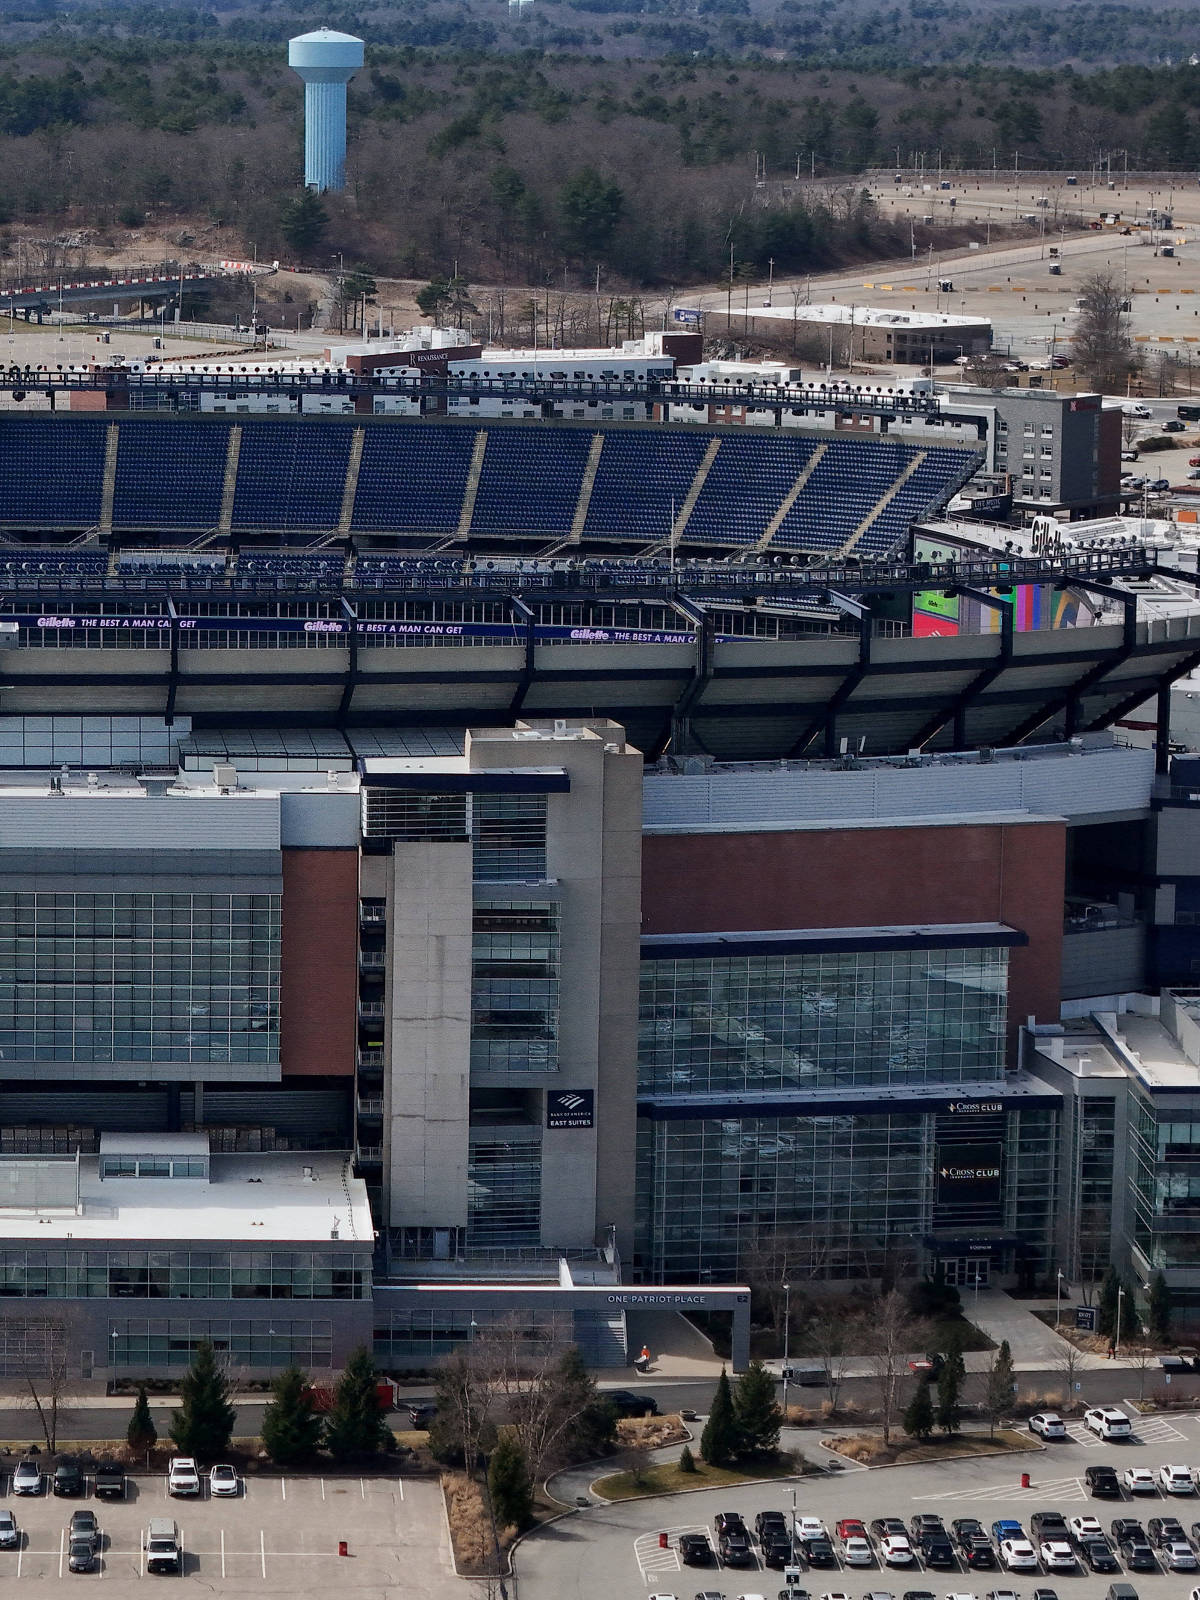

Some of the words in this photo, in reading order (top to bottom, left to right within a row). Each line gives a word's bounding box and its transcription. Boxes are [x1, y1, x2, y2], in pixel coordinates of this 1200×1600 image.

[37, 617, 76, 628] Gillette
[81, 619, 97, 627] THE
[100, 619, 120, 627] BEST
[122, 619, 129, 627] A
[132, 619, 154, 628] MAN
[157, 620, 172, 628] CA
[179, 620, 197, 628] GET
[304, 621, 342, 632] Gillette
[366, 624, 387, 632] BEST
[389, 624, 396, 632] A
[398, 624, 421, 633] MAN
[424, 625, 443, 634] CAN
[446, 626, 464, 634] GET
[571, 628, 609, 640] Gillette
[614, 631, 630, 640] THE
[632, 632, 652, 641] BEST
[654, 634, 661, 642] A
[663, 634, 685, 643] MAN
[976, 1169, 1000, 1177] CLUB
[607, 1295, 628, 1303] ONE
[631, 1295, 672, 1303] PATRIOT
[737, 1295, 748, 1303] E2
[790, 1575, 795, 1583] 5
